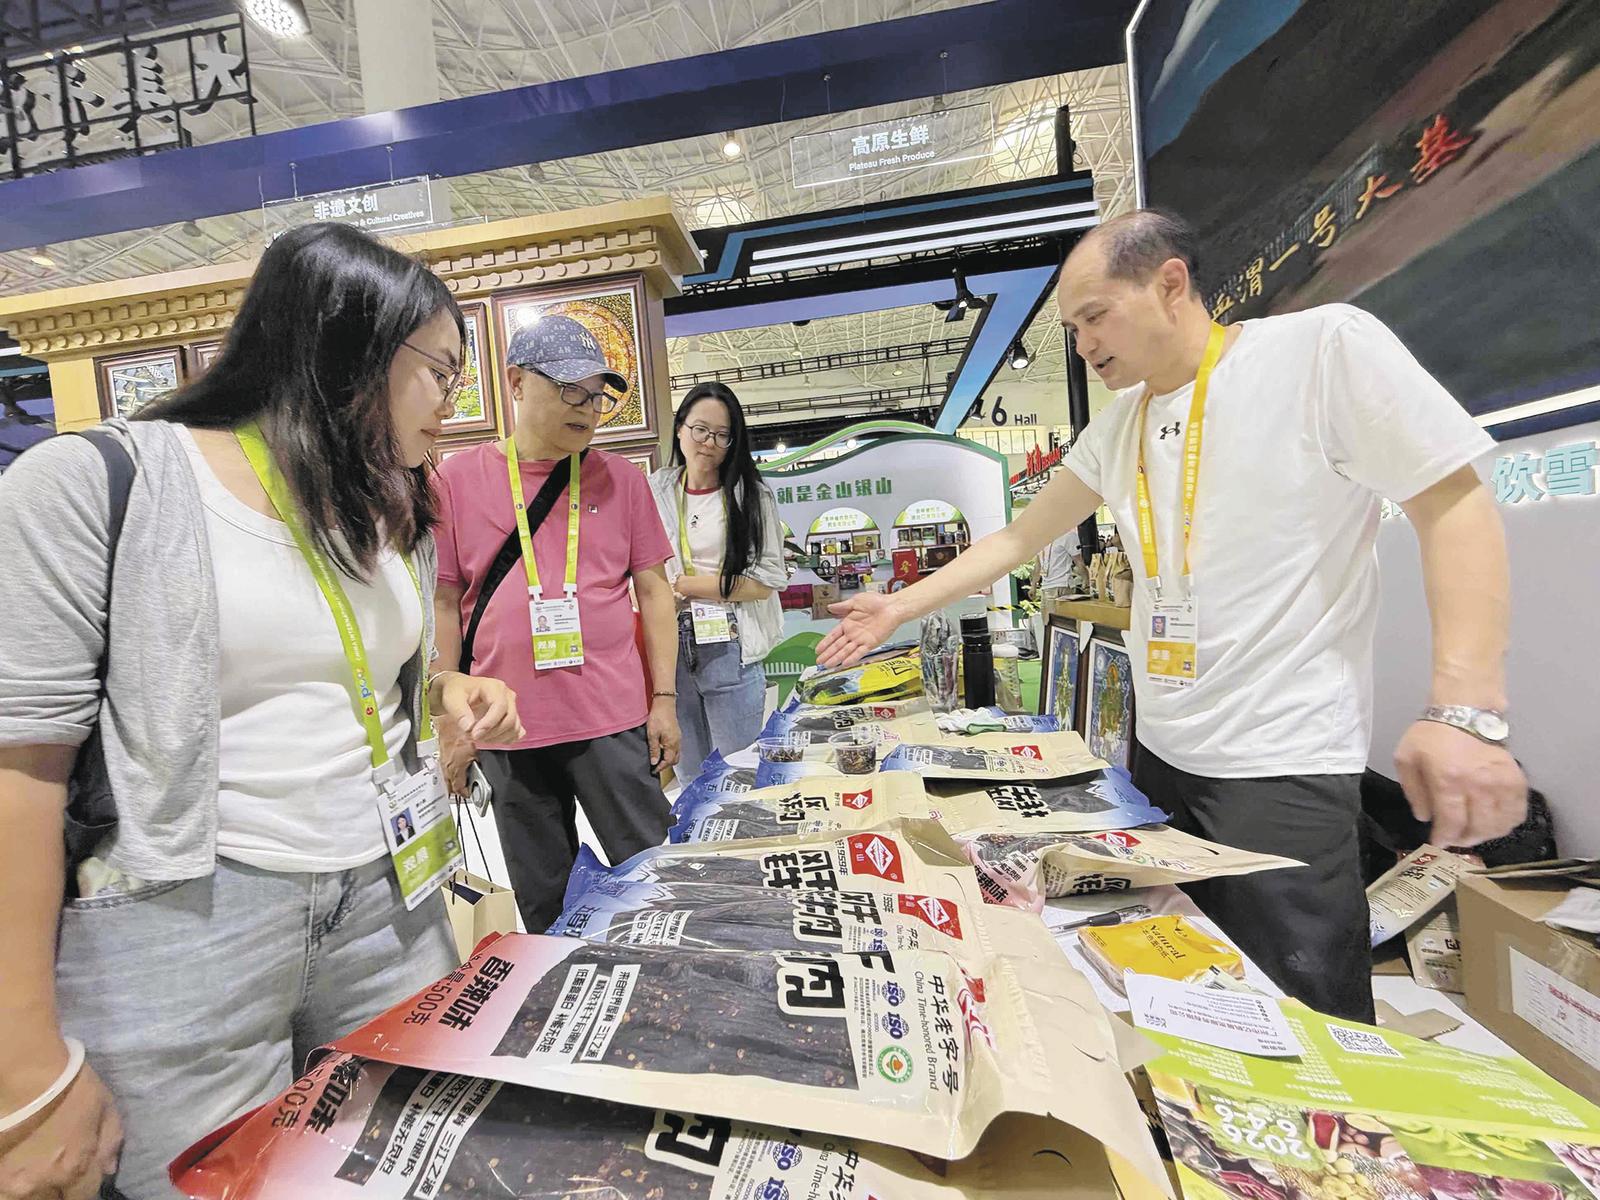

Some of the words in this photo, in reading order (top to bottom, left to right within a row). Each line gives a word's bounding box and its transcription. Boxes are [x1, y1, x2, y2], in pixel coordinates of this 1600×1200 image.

[851, 124, 929, 157] 高原生鲜
[849, 159, 878, 172] Plateau
[879, 156, 900, 167] Fresh
[902, 150, 935, 163] Produce
[314, 193, 379, 220] 非遗文创
[367, 214, 392, 226] Cultural
[393, 210, 425, 222] Creatives
[992, 396, 1007, 426] 6
[1014, 413, 1037, 425] Hall
[776, 477, 892, 504] 就是金山银山
[799, 849, 838, 894] 风干
[841, 890, 880, 926] 风干
[904, 927, 921, 951] 中华
[1148, 923, 1187, 961] Natural
[438, 954, 515, 1032] 香辣味
[885, 980, 903, 1007] ISO
[914, 971, 926, 992] China
[584, 1023, 610, 1061] 三江之源
[886, 1012, 903, 1040] ISO
[916, 996, 936, 1057] Time-honored
[929, 974, 959, 1096] 中华老字号
[926, 1060, 940, 1092] Brand
[777, 1139, 798, 1172] ISO
[1227, 1125, 1312, 1163] 2026
[417, 1132, 459, 1195] 三江之源
